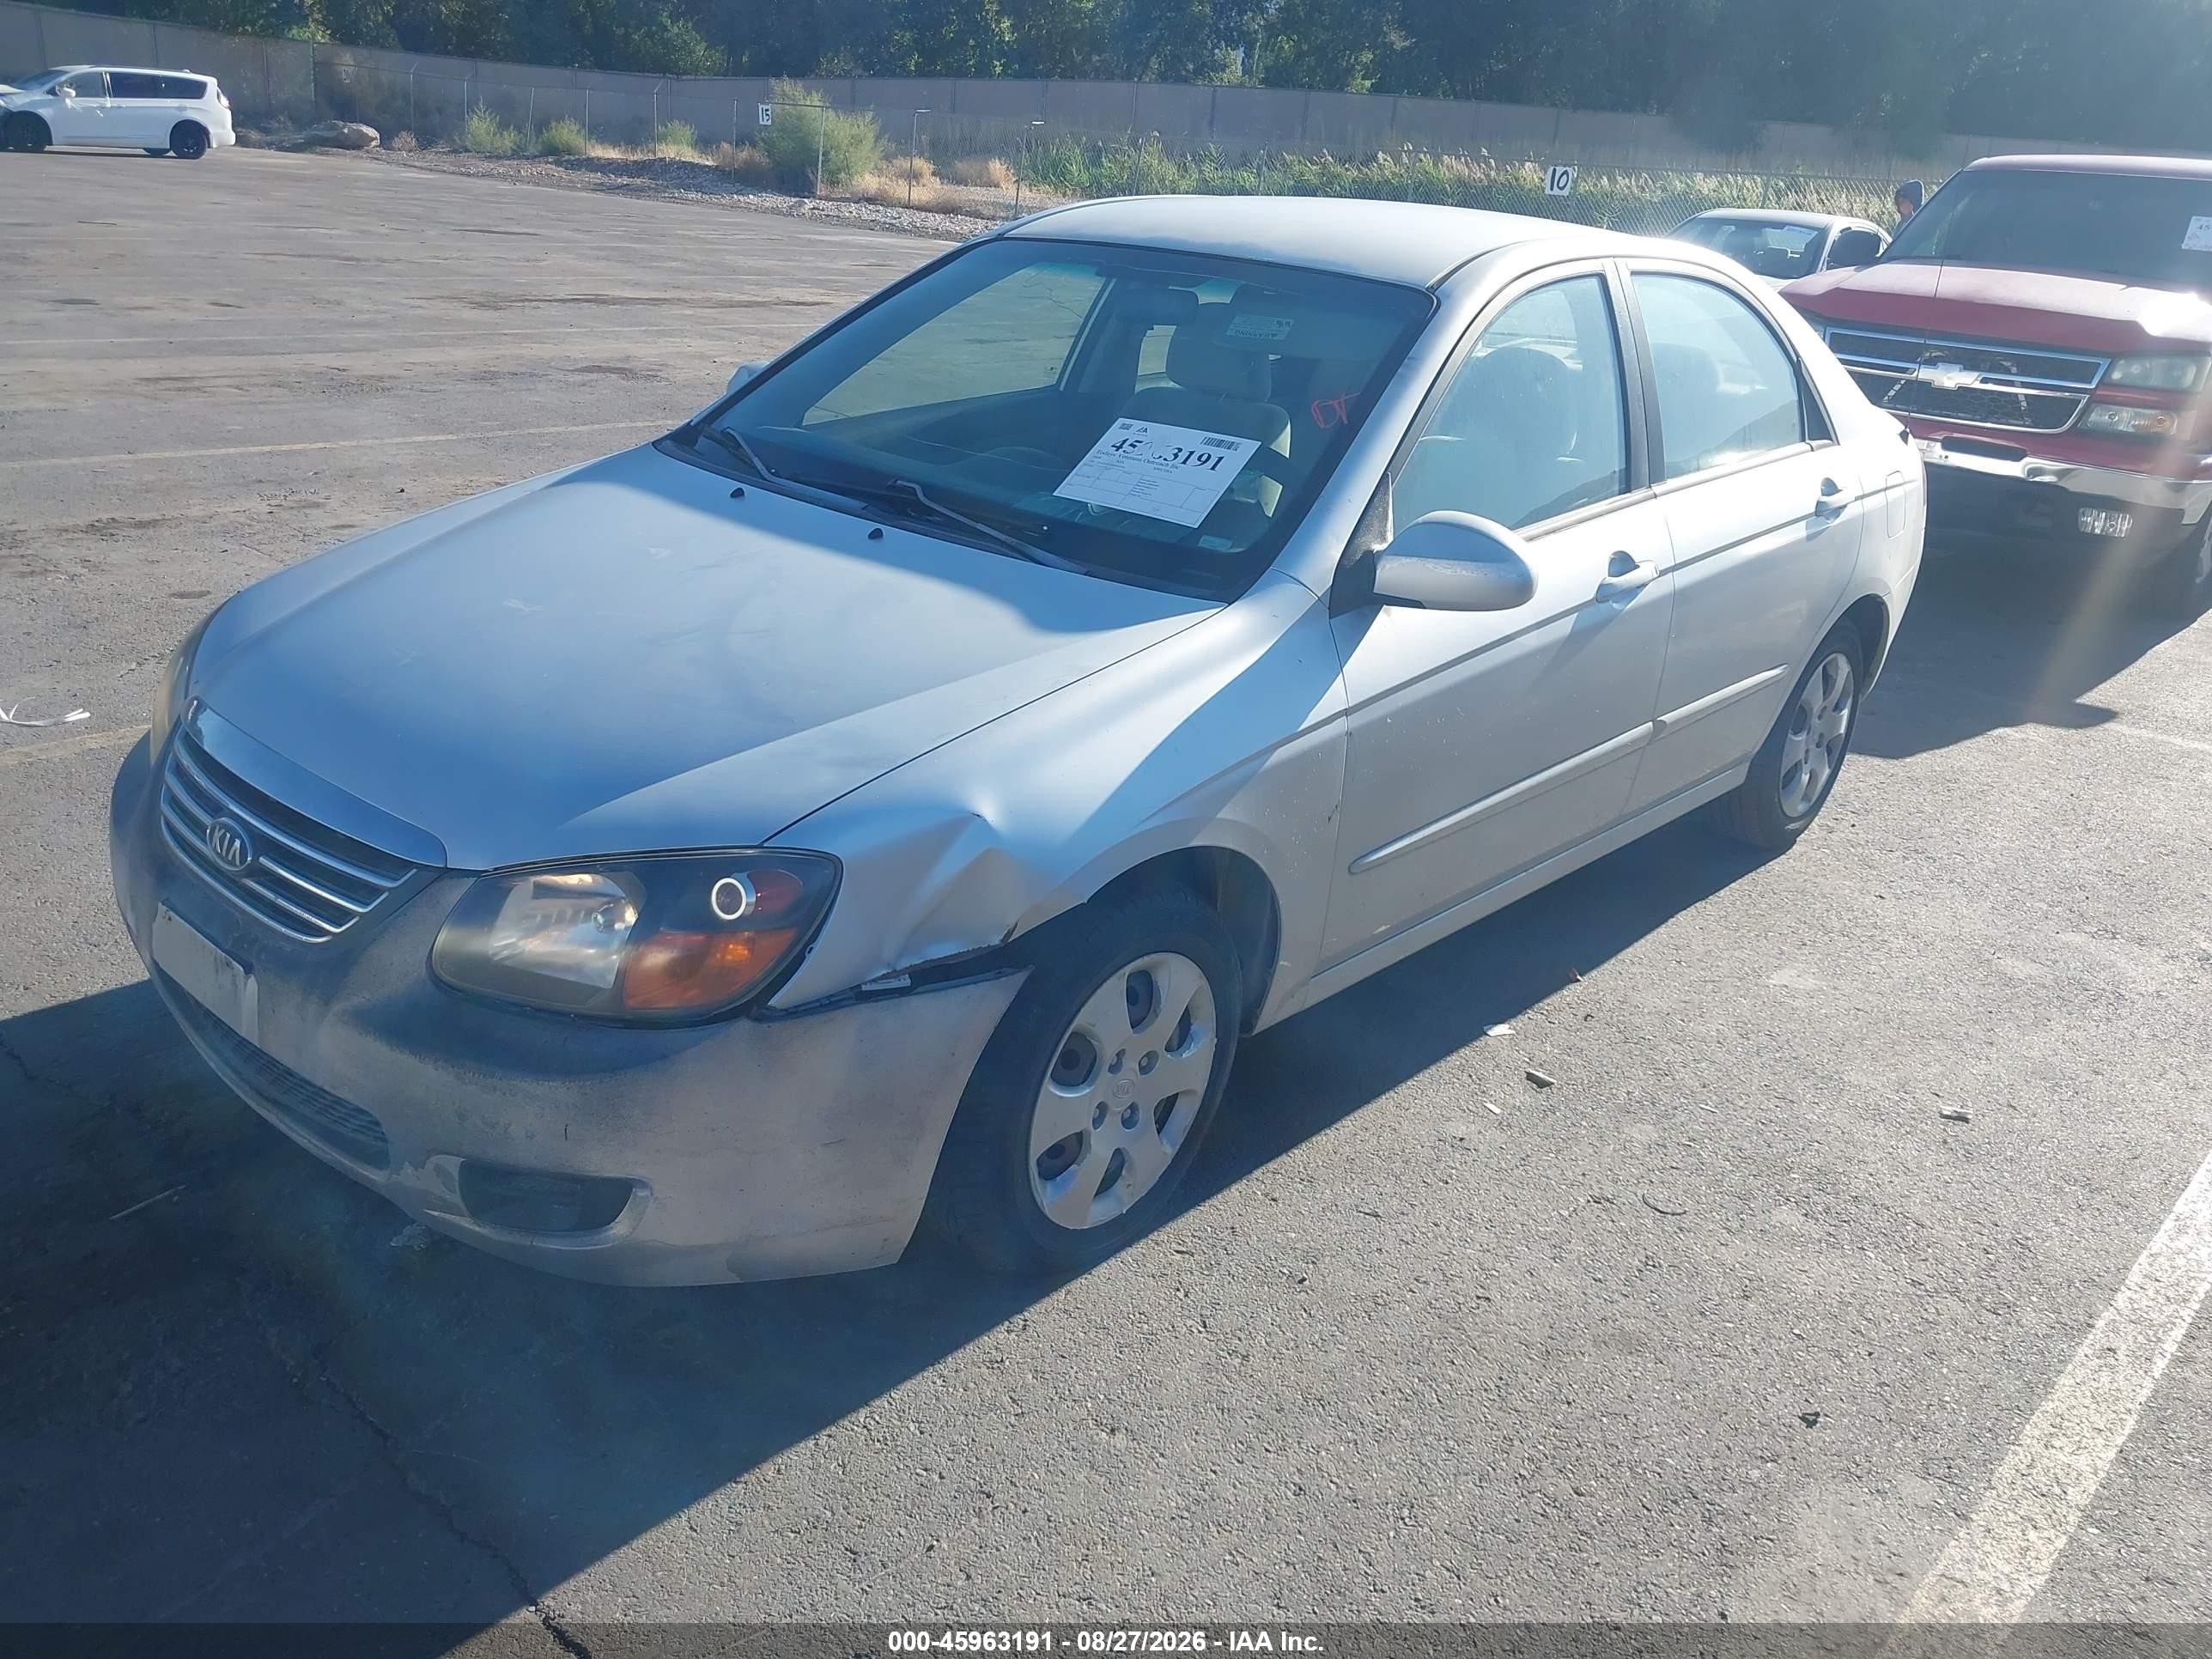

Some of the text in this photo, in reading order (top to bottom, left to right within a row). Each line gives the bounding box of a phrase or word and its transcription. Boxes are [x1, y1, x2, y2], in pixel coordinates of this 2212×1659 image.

[761, 106, 770, 122] 15
[1549, 167, 1570, 191] 10
[212, 823, 240, 866] KIA
